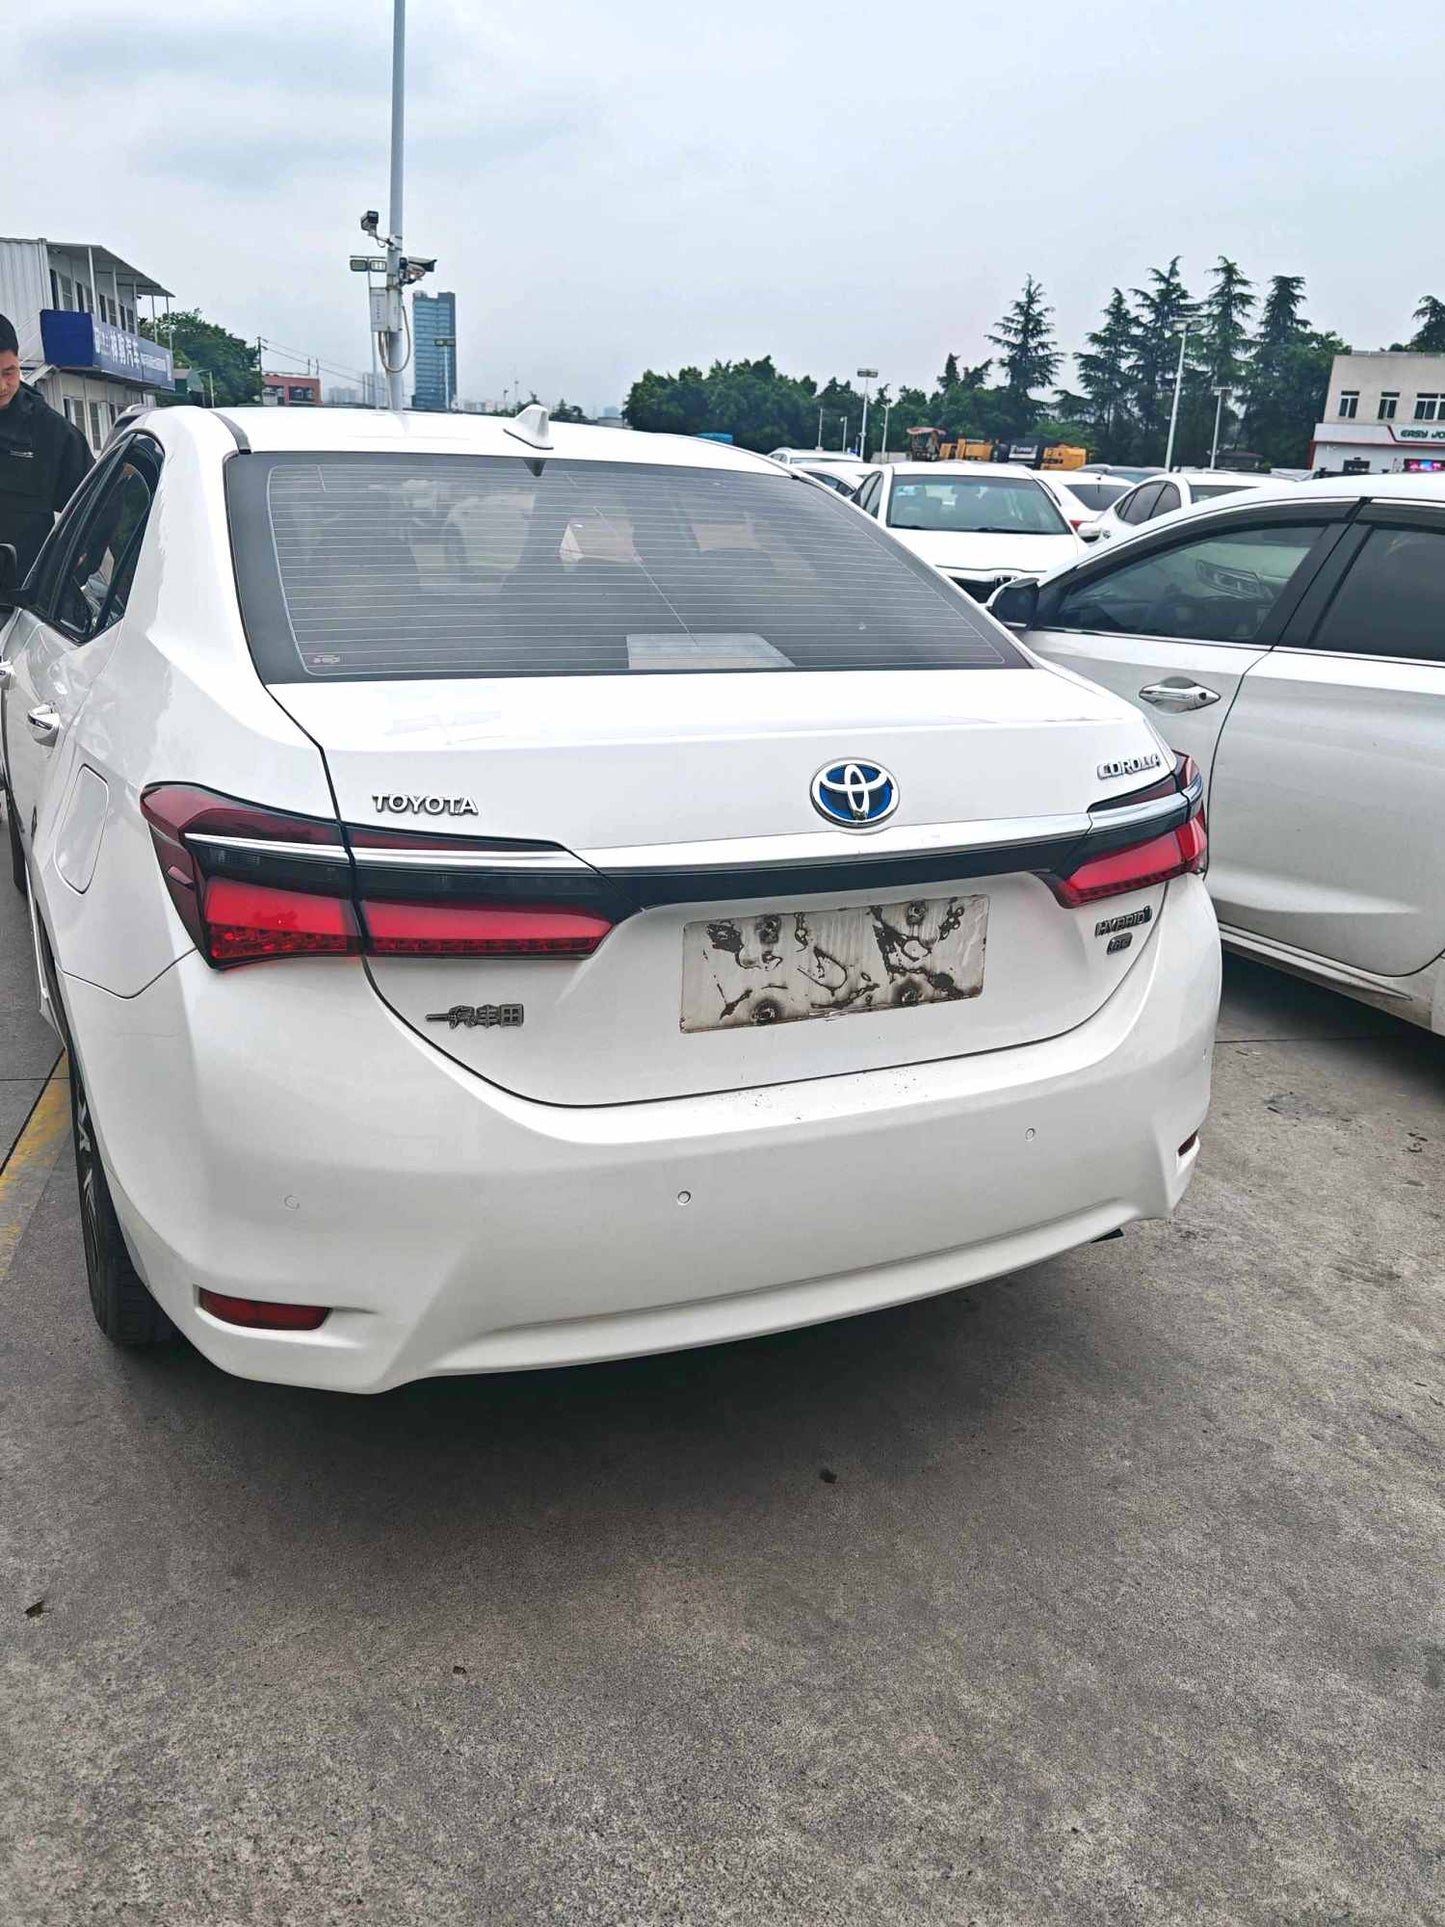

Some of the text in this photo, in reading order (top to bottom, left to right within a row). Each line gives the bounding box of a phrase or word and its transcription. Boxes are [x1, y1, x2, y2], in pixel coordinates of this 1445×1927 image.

[1400, 429, 1428, 438] EASY
[1097, 753, 1161, 780] COROLLA
[372, 794, 479, 816] TOYOTA
[1095, 909, 1147, 938] HYBRID
[425, 1003, 524, 1029] 一汽丰田
